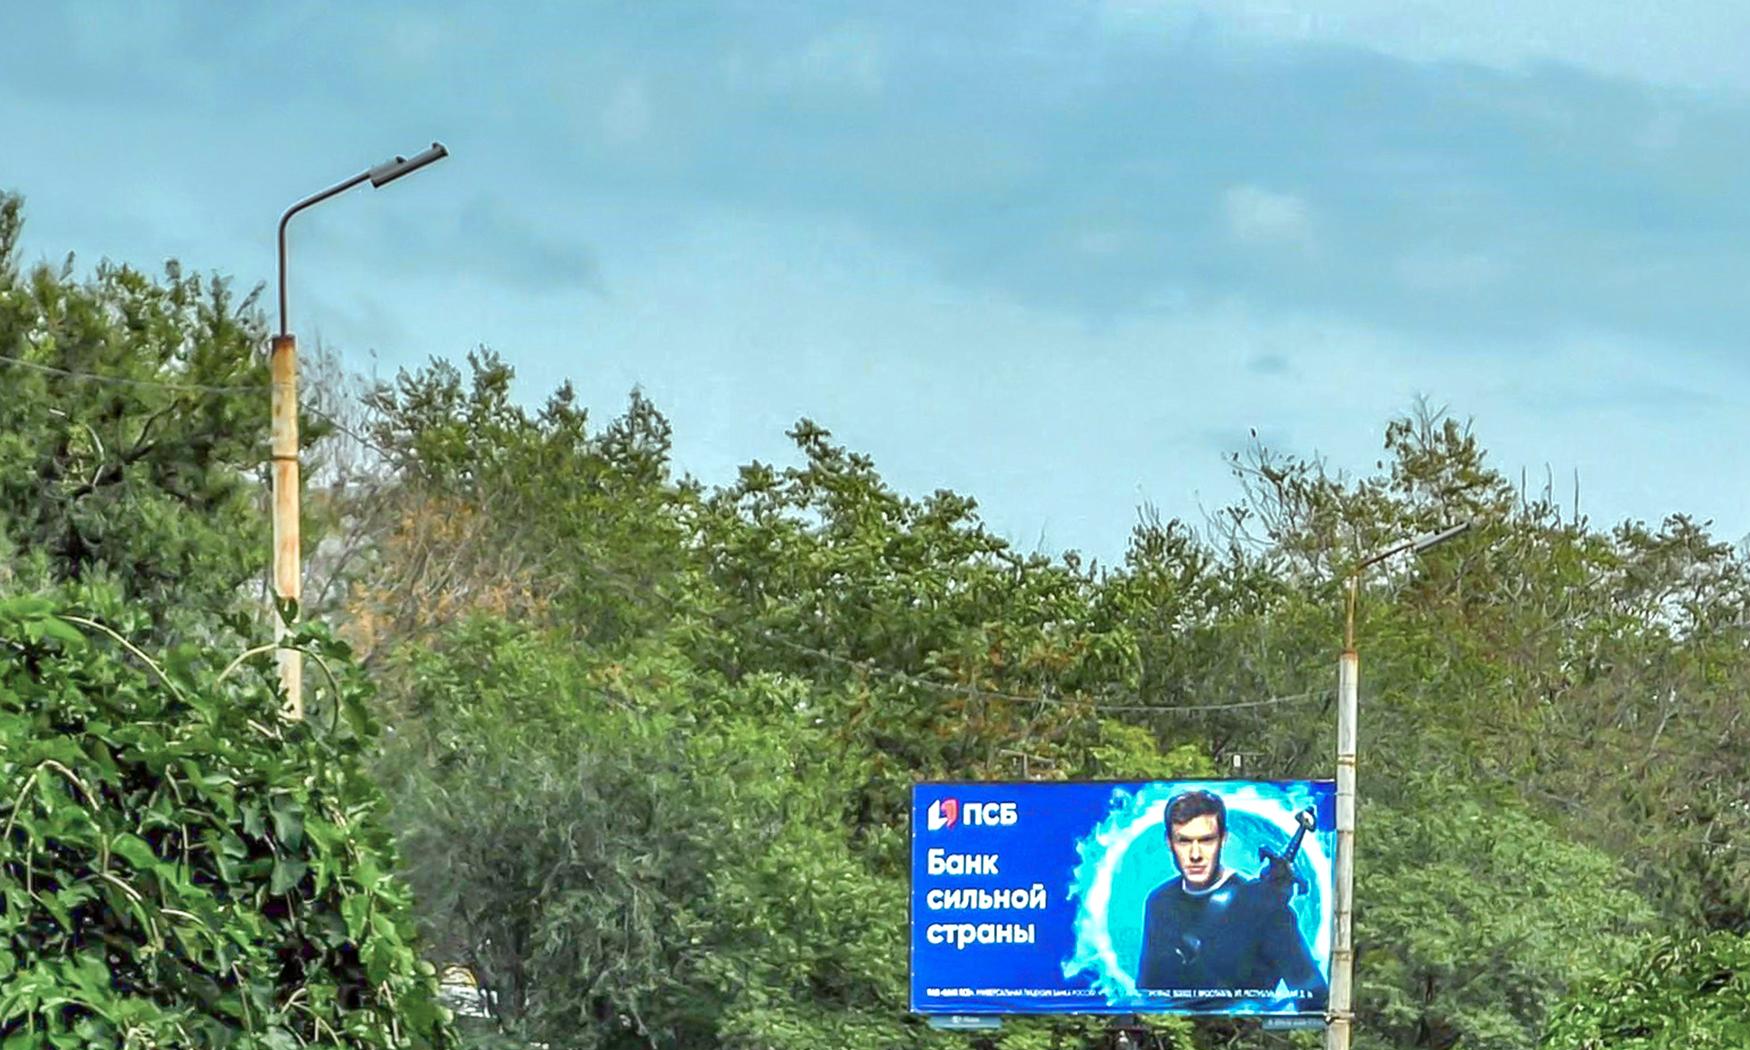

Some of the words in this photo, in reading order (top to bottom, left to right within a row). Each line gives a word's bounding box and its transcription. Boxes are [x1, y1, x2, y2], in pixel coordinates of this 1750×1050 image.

[963, 802, 1018, 826] ПСБ
[928, 848, 999, 875] Банк
[926, 883, 1047, 910] сильной
[926, 923, 1035, 949] страны
